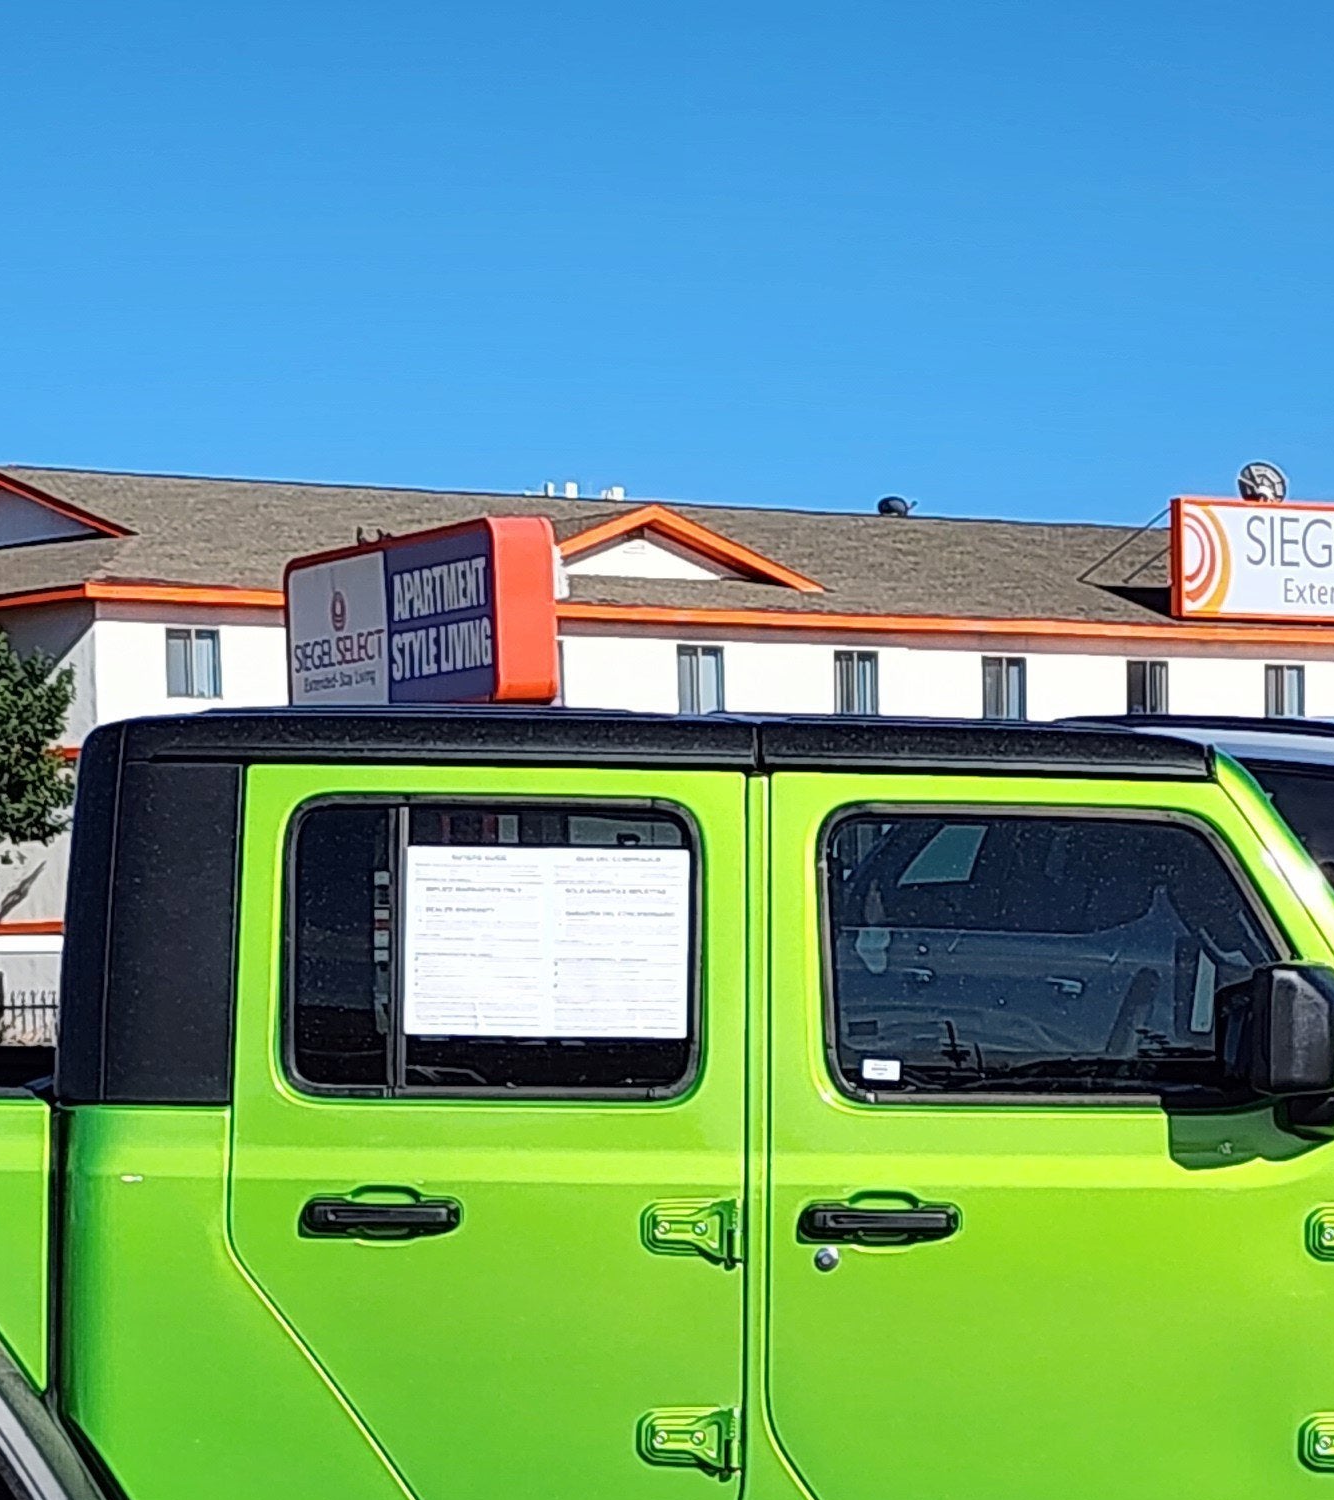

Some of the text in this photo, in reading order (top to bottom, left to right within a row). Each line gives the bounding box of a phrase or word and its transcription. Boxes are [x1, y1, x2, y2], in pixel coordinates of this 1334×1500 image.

[392, 556, 487, 623] APARTMENT
[336, 628, 385, 665] SELECT
[391, 616, 493, 683] STYLE LIVING
